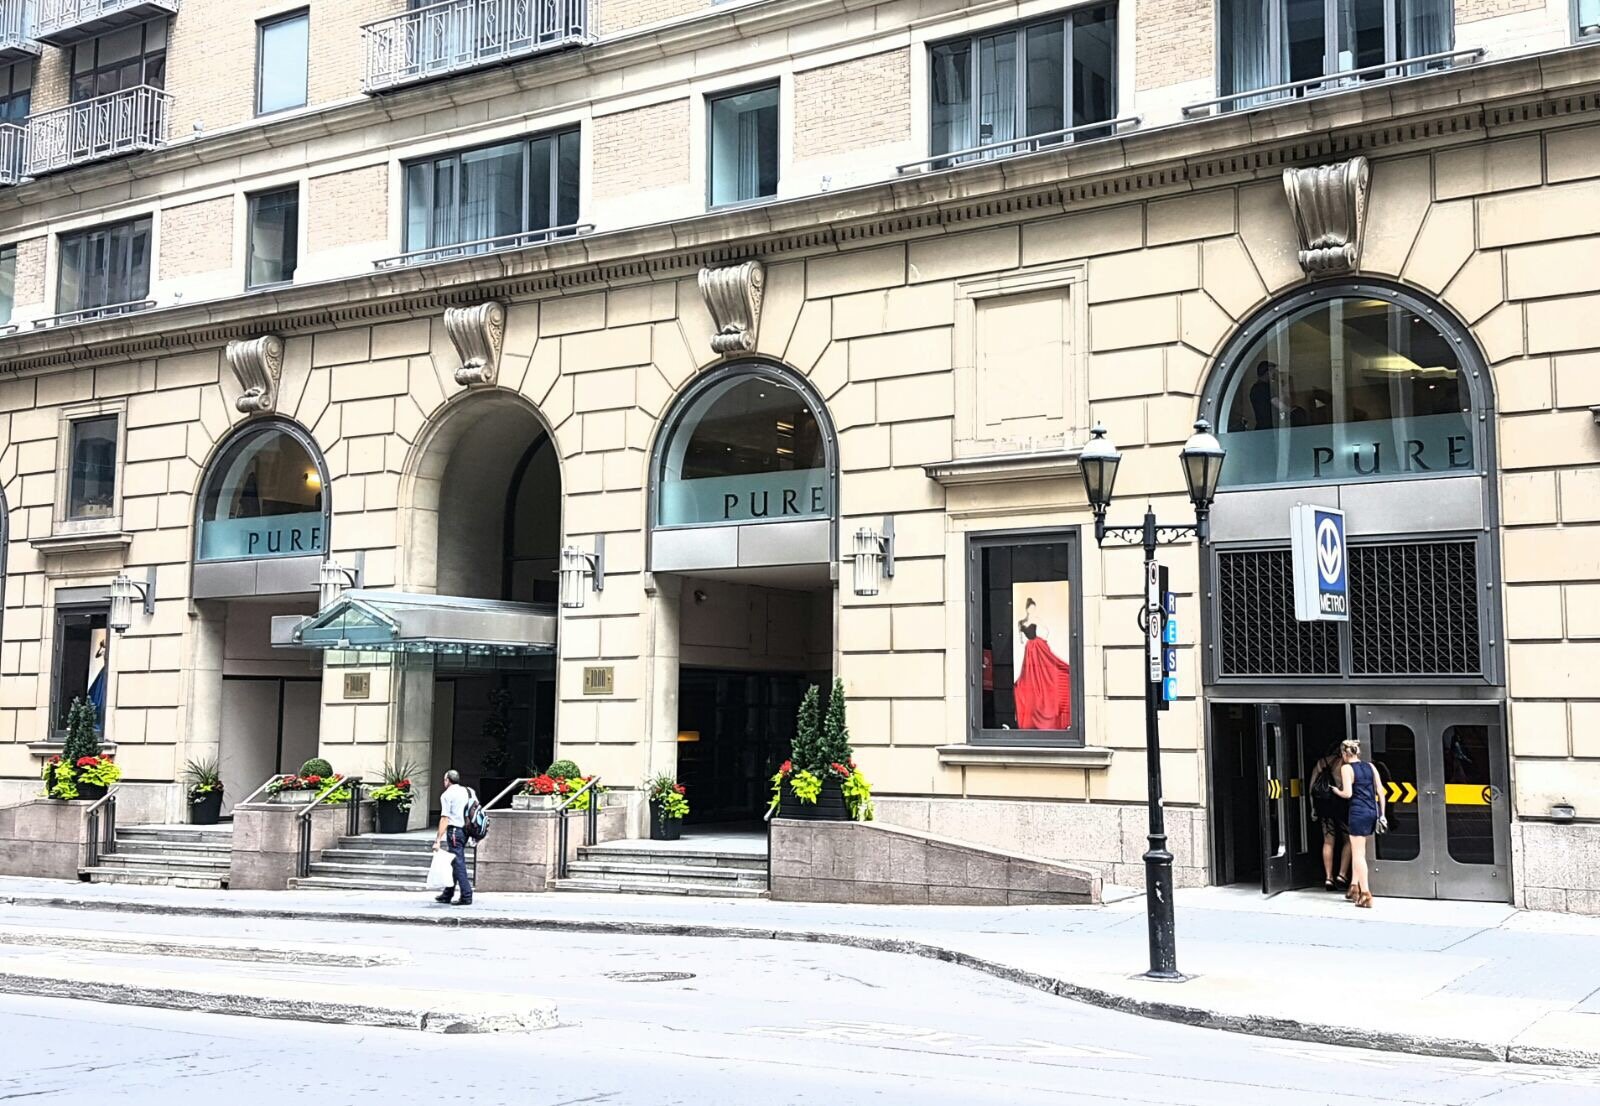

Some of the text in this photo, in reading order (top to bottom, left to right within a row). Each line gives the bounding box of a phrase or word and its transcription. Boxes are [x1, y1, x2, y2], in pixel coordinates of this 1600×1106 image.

[1313, 436, 1470, 477] PURE
[724, 487, 825, 518] PURE
[248, 527, 321, 553] PURE
